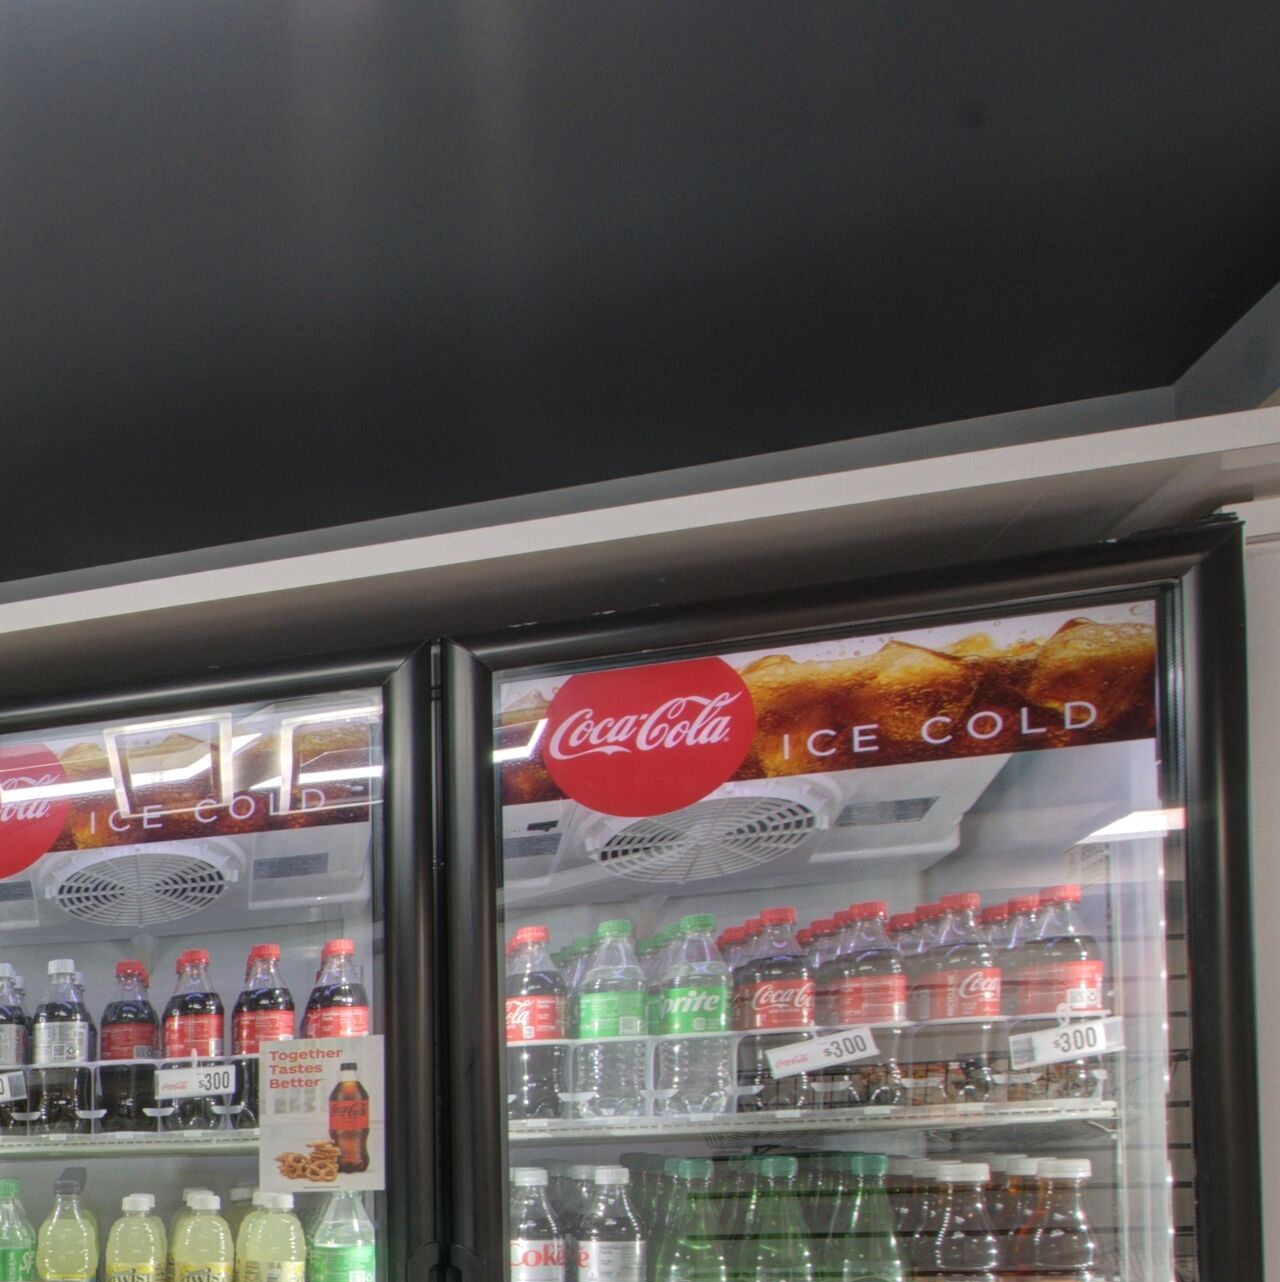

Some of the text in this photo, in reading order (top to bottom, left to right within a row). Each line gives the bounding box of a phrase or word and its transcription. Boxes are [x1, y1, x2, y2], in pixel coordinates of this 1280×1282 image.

[550, 691, 743, 760] Coca-Cola
[782, 700, 1098, 761] ICE COLD
[90, 788, 327, 835] ICE COLD
[269, 1048, 343, 1062] Together
[269, 1064, 323, 1075] Tastes
[269, 1078, 321, 1089] Better
[509, 1241, 565, 1269] Coke
